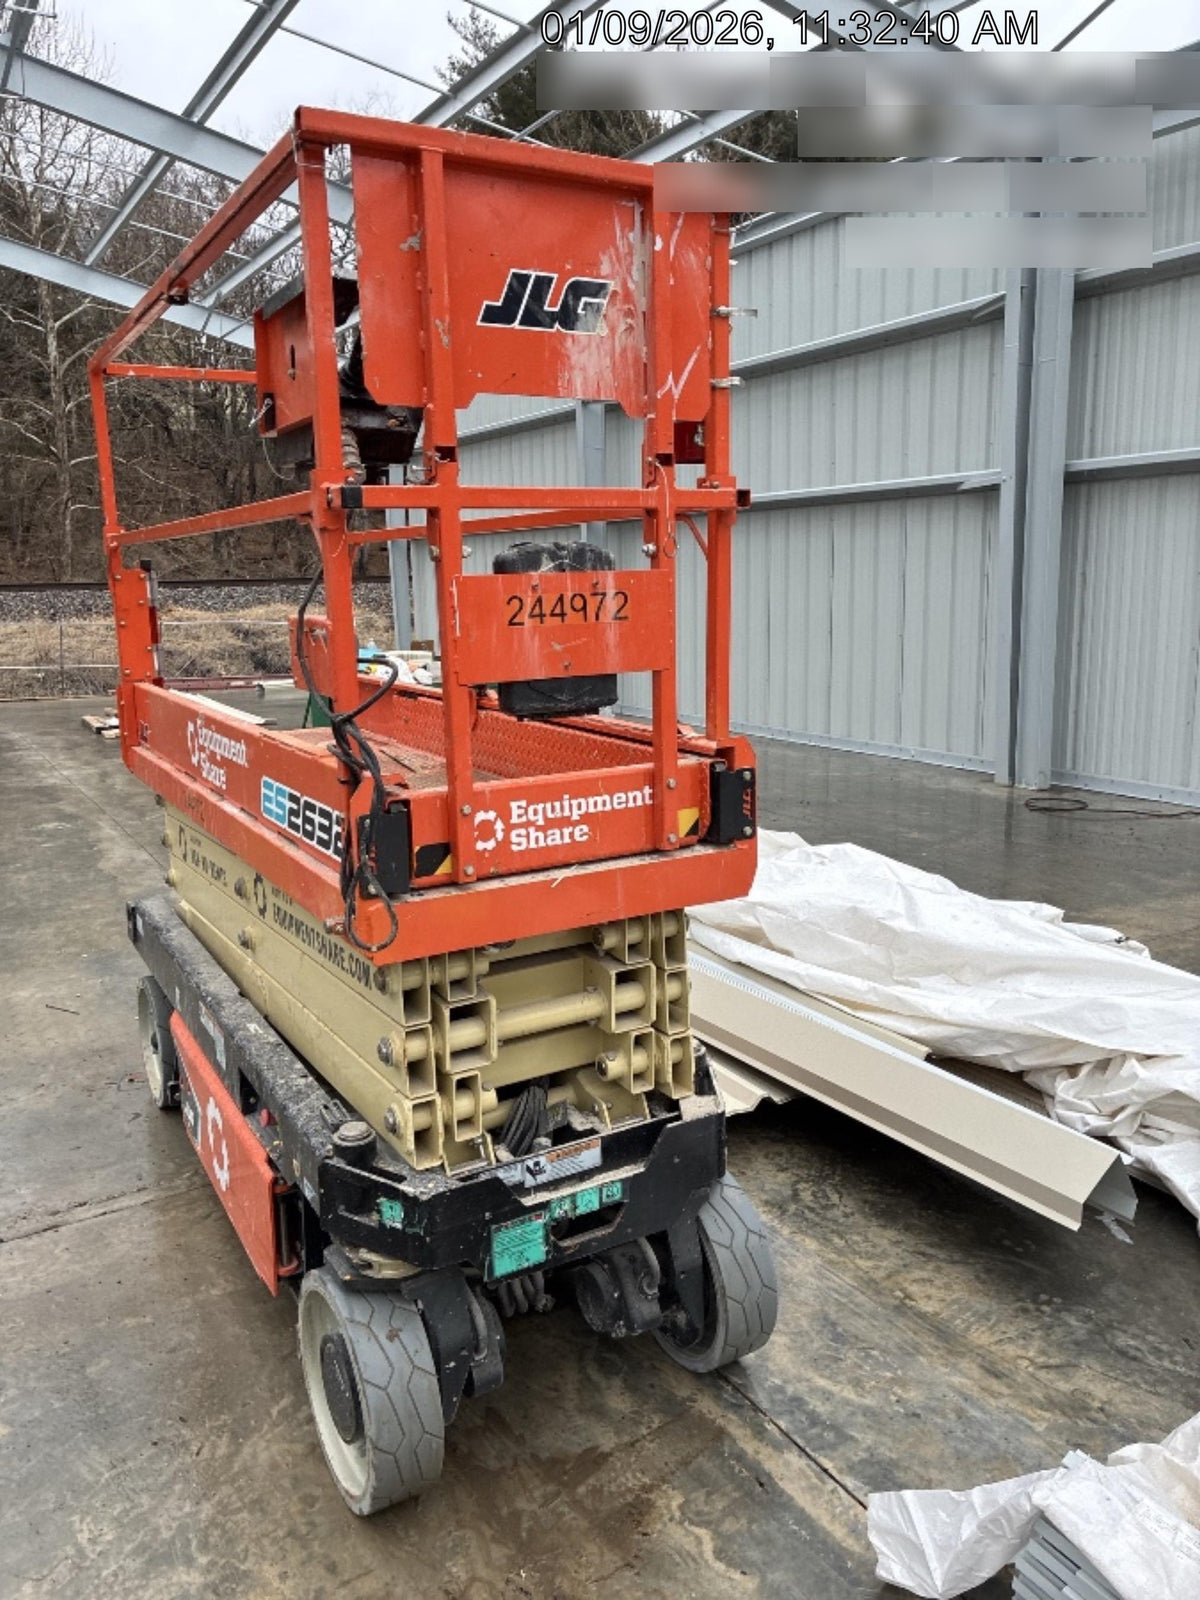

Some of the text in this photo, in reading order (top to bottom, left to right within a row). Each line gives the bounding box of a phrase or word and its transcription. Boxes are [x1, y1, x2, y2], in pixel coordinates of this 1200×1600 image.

[476, 268, 614, 335] JLG
[506, 591, 629, 626] 244972
[509, 785, 654, 826] Equipment
[510, 823, 590, 852] Share
